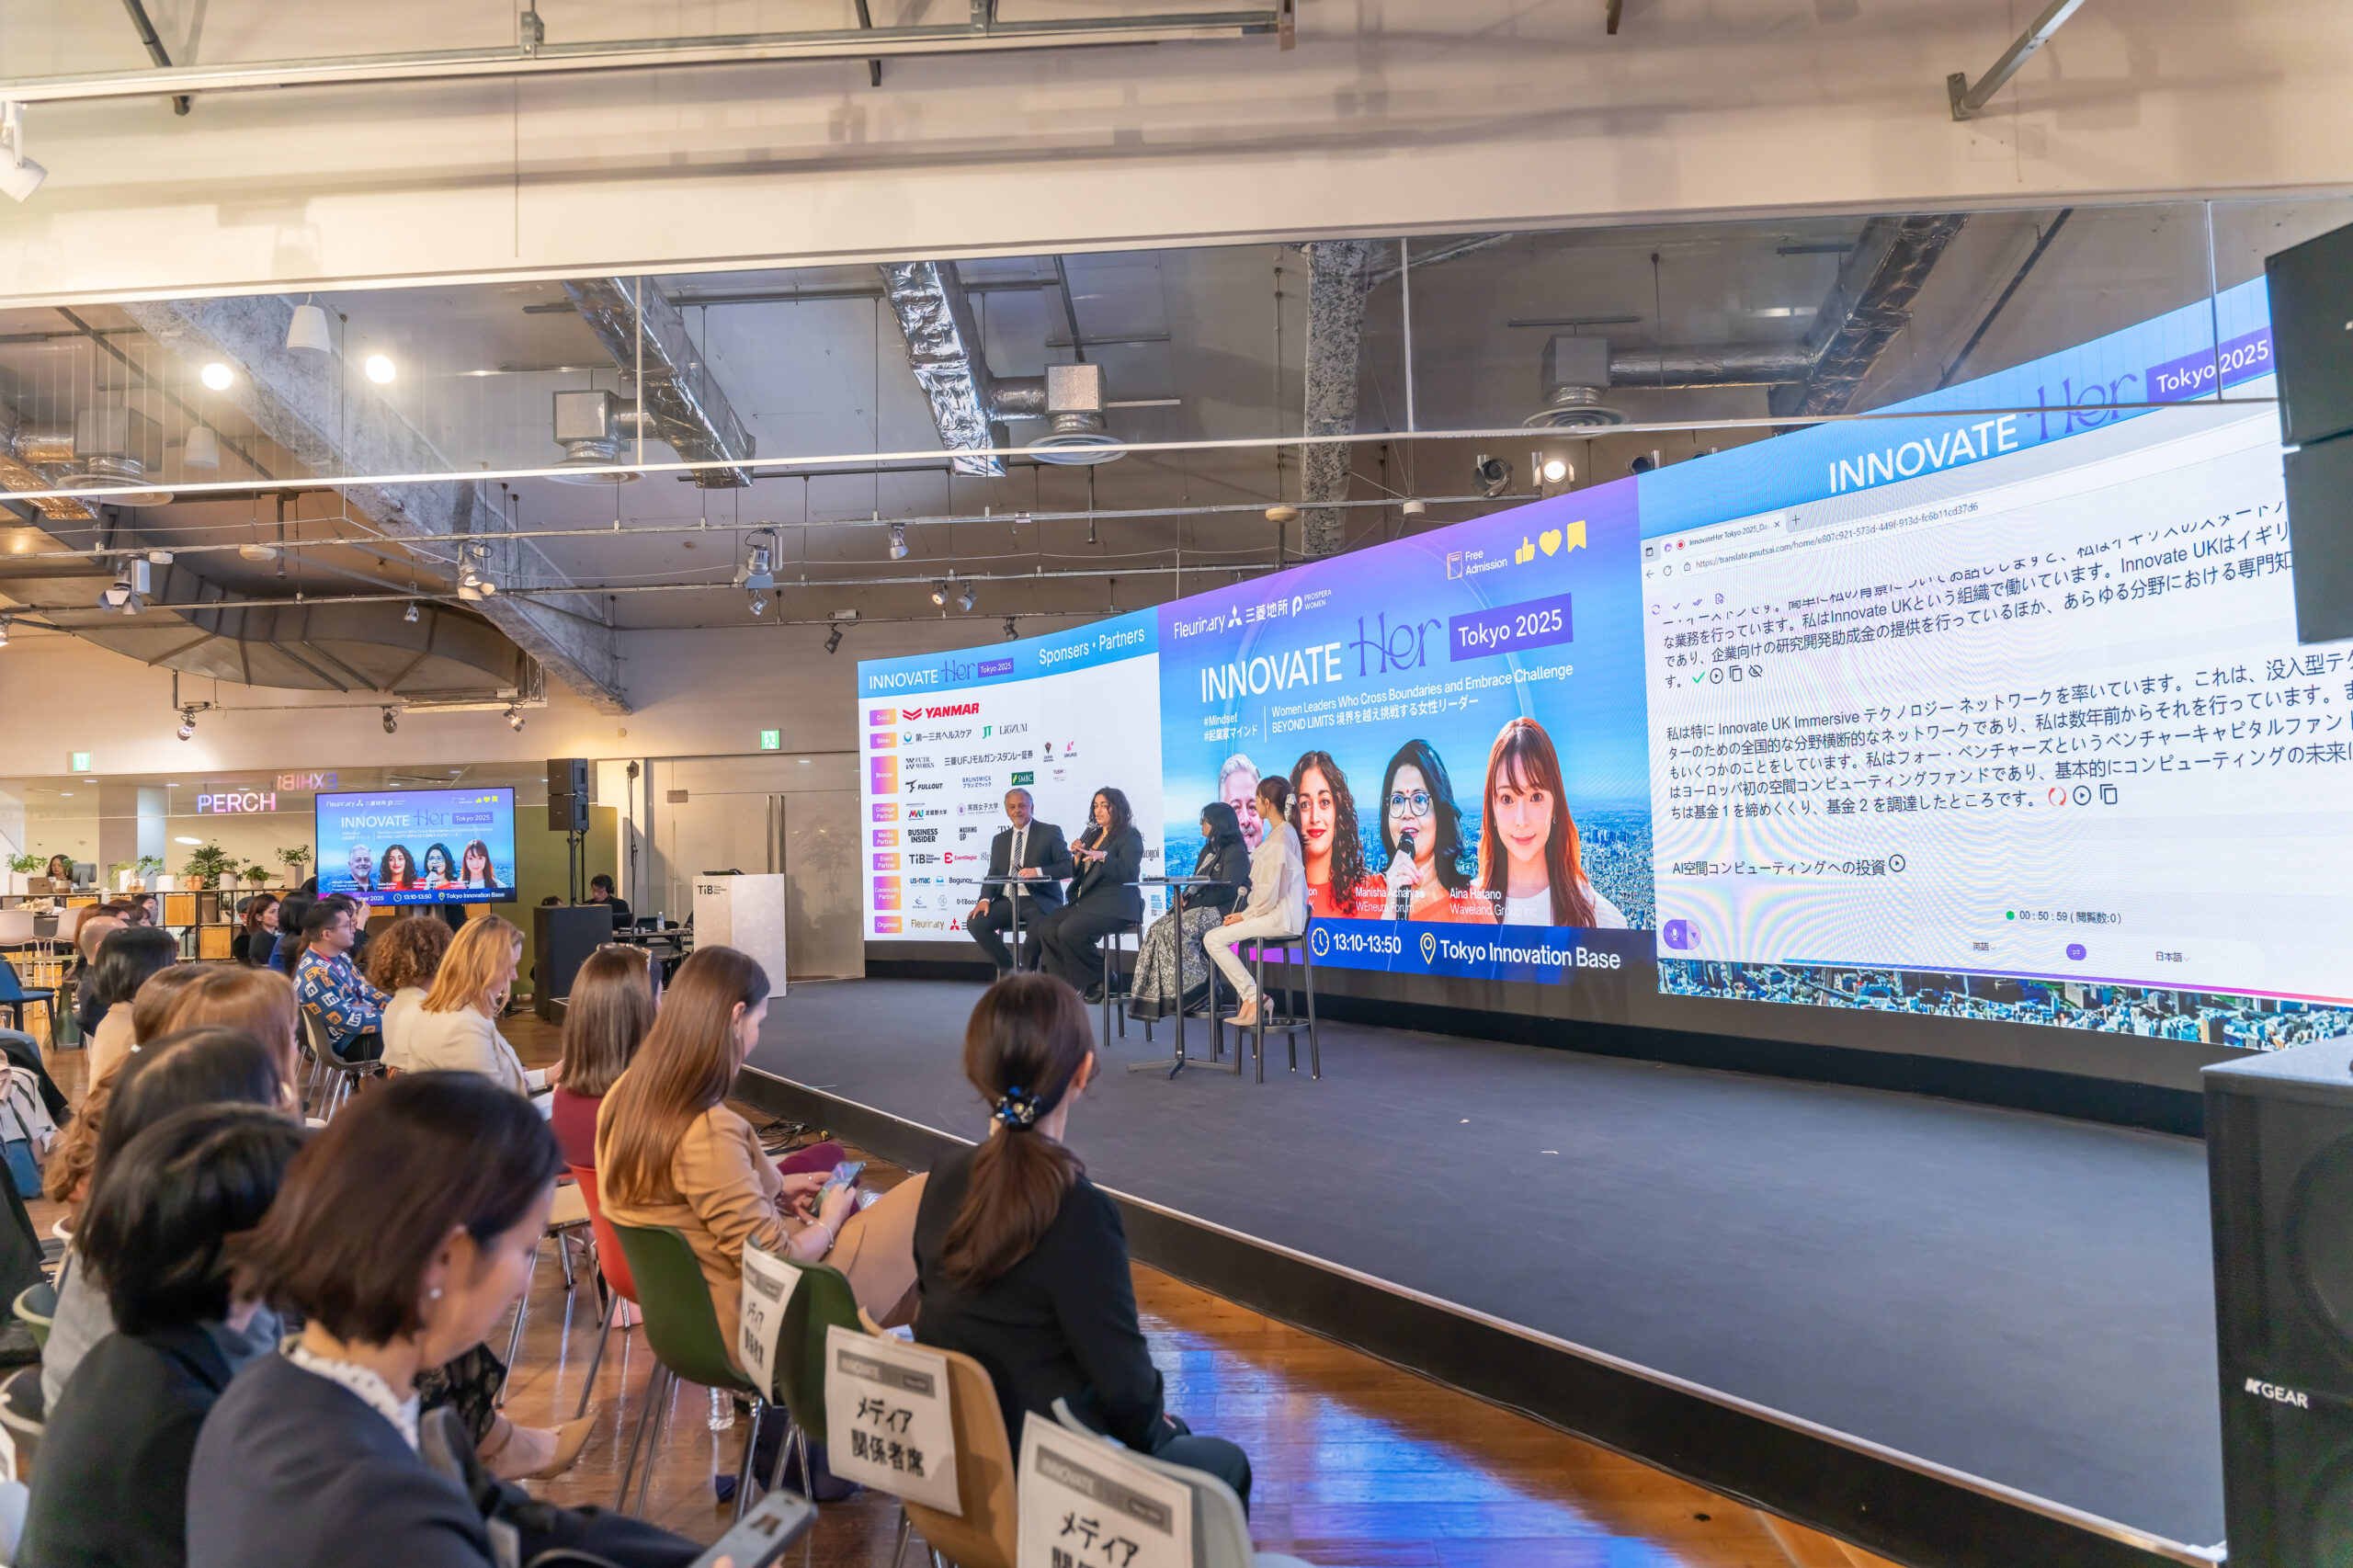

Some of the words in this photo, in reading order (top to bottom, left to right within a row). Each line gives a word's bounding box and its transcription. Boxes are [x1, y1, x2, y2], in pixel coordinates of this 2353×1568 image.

[1829, 413, 2018, 493] INNOVATE
[2026, 373, 2139, 441] Her
[2155, 364, 2216, 393] Tokyo
[2219, 339, 2269, 374] 2025
[1465, 551, 1484, 562] Free
[1465, 558, 1508, 576] Admission
[1304, 589, 1332, 602] PROSPERA
[1245, 599, 1289, 623] 三菱地所
[1304, 599, 1326, 610] WOMEN
[1039, 642, 1090, 667] Sponsers
[1099, 628, 1145, 653] Partners
[1201, 642, 1343, 702] INNOVATE
[1348, 611, 1442, 676] Her
[1458, 622, 1510, 649] Tokyo
[1516, 608, 1563, 638] 2025
[870, 668, 938, 690] INNOVATE
[940, 659, 976, 683] Her
[980, 663, 997, 676] Tokyo
[998, 661, 1012, 672] 2025
[1665, 674, 1682, 689] す。
[1272, 704, 1303, 718] Women
[1303, 699, 1337, 713] Leaders
[1338, 696, 1359, 709] Who
[1360, 692, 1387, 706] Cross
[1389, 683, 1443, 702] Boundaries
[1444, 678, 1463, 693] and
[1465, 673, 1512, 691] Embrace
[1514, 665, 1574, 683] Challenge
[925, 703, 980, 719] YANMAR
[1272, 719, 1306, 734] BEYOND
[1307, 715, 1336, 730] LIMITS
[1336, 695, 1480, 726] 境界を越え挑戦する女性リーダー
[1203, 712, 1238, 727] #Mindset
[1666, 722, 1715, 742] 私は特に
[1718, 721, 1768, 736] Innovate
[1772, 716, 1790, 731] UK
[1794, 710, 1859, 729] Immersive
[1864, 702, 1954, 723] テクノロジー
[915, 730, 972, 742] 第一三共ヘルスケア
[983, 725, 993, 739] JT
[962, 775, 992, 783] BRUNSWICK
[1017, 774, 1033, 783] SMBC
[197, 792, 276, 813] PERCH
[341, 814, 410, 828] INNOVATE
[413, 809, 450, 826] Her
[908, 828, 938, 836] BUSINESS
[960, 833, 967, 841] UP
[909, 854, 926, 864] TiB
[698, 885, 713, 894] TiB
[1355, 886, 1386, 898] Manisha
[1449, 887, 1469, 899] Aina
[1470, 888, 1502, 900] Hatano
[1390, 902, 1415, 913] Forum
[1449, 903, 1493, 916] Waveland
[1333, 933, 1402, 955] 13:10-13:50
[1439, 939, 1486, 964] Tokyo
[1489, 942, 1573, 967] Innovation
[1575, 947, 1621, 970] Base
[2155, 951, 2183, 962] 日本語
[857, 1396, 914, 1434] メディア
[1061, 1512, 1140, 1568] メディア
